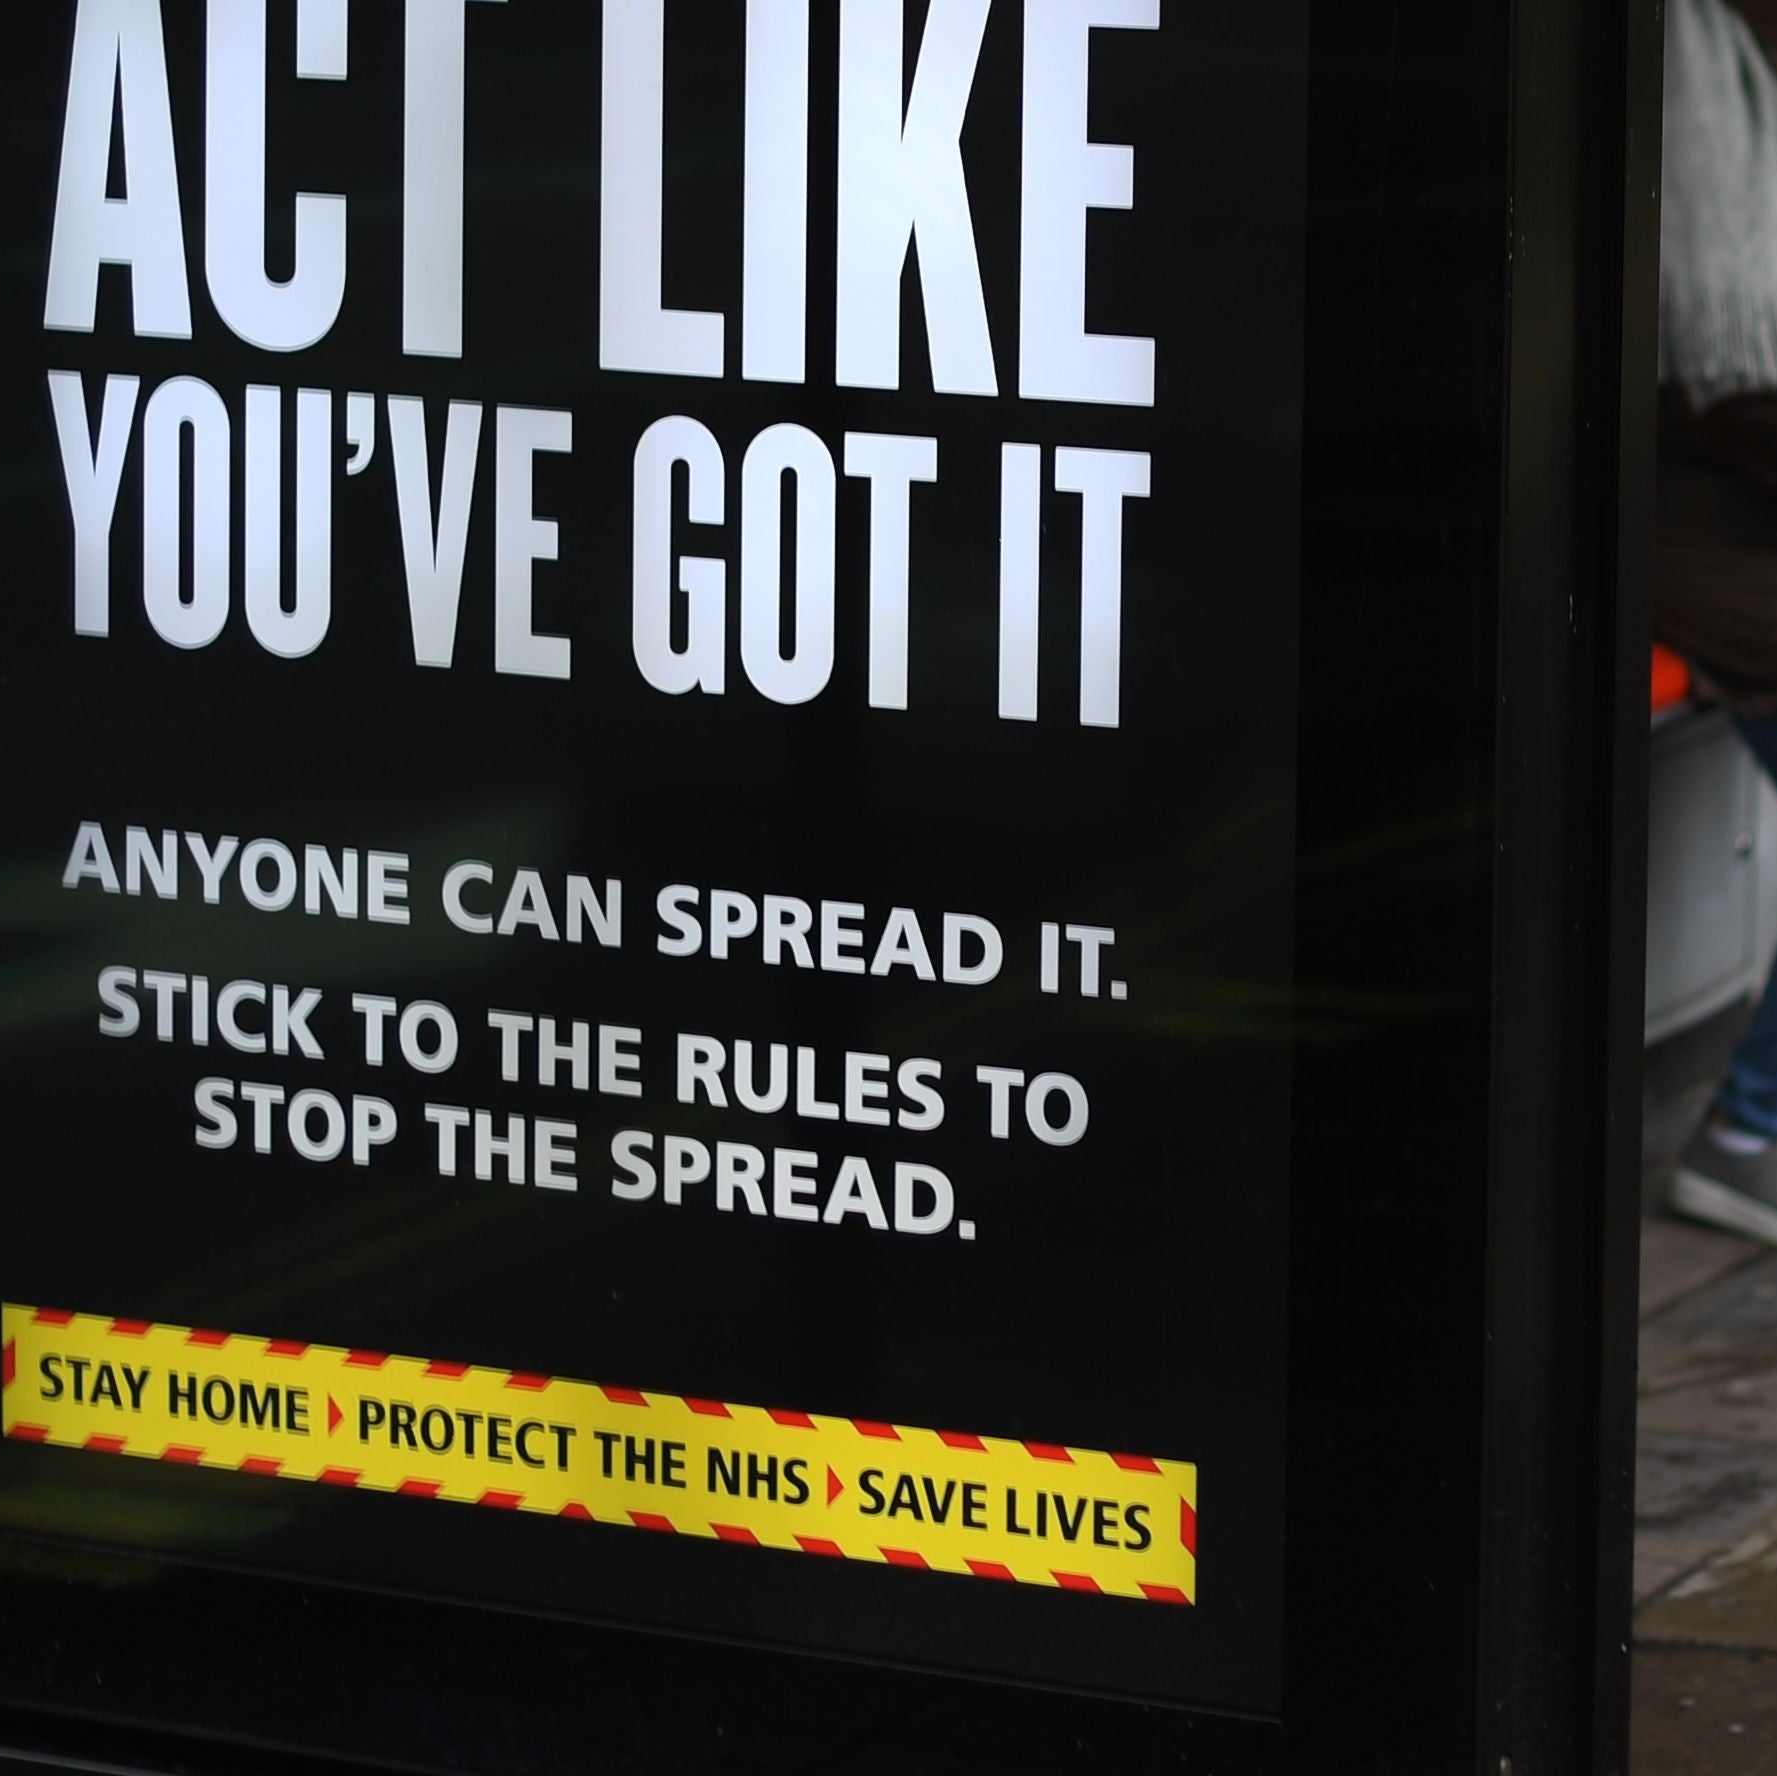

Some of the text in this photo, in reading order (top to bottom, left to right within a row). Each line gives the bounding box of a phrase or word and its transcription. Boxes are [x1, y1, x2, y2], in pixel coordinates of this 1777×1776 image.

[48, 370, 1151, 728] YOU’VE GOT IT
[63, 822, 1127, 1000] ANYONE CAN SPREAD IT.
[98, 966, 1088, 1146] STICK TO THE RULES TO
[195, 1077, 975, 1240] STOP THE SPREAD.
[40, 1356, 308, 1432] STAY HOME
[360, 1400, 809, 1504] PROTECT THE NHS
[859, 1470, 1151, 1550] SAVE LIVES
